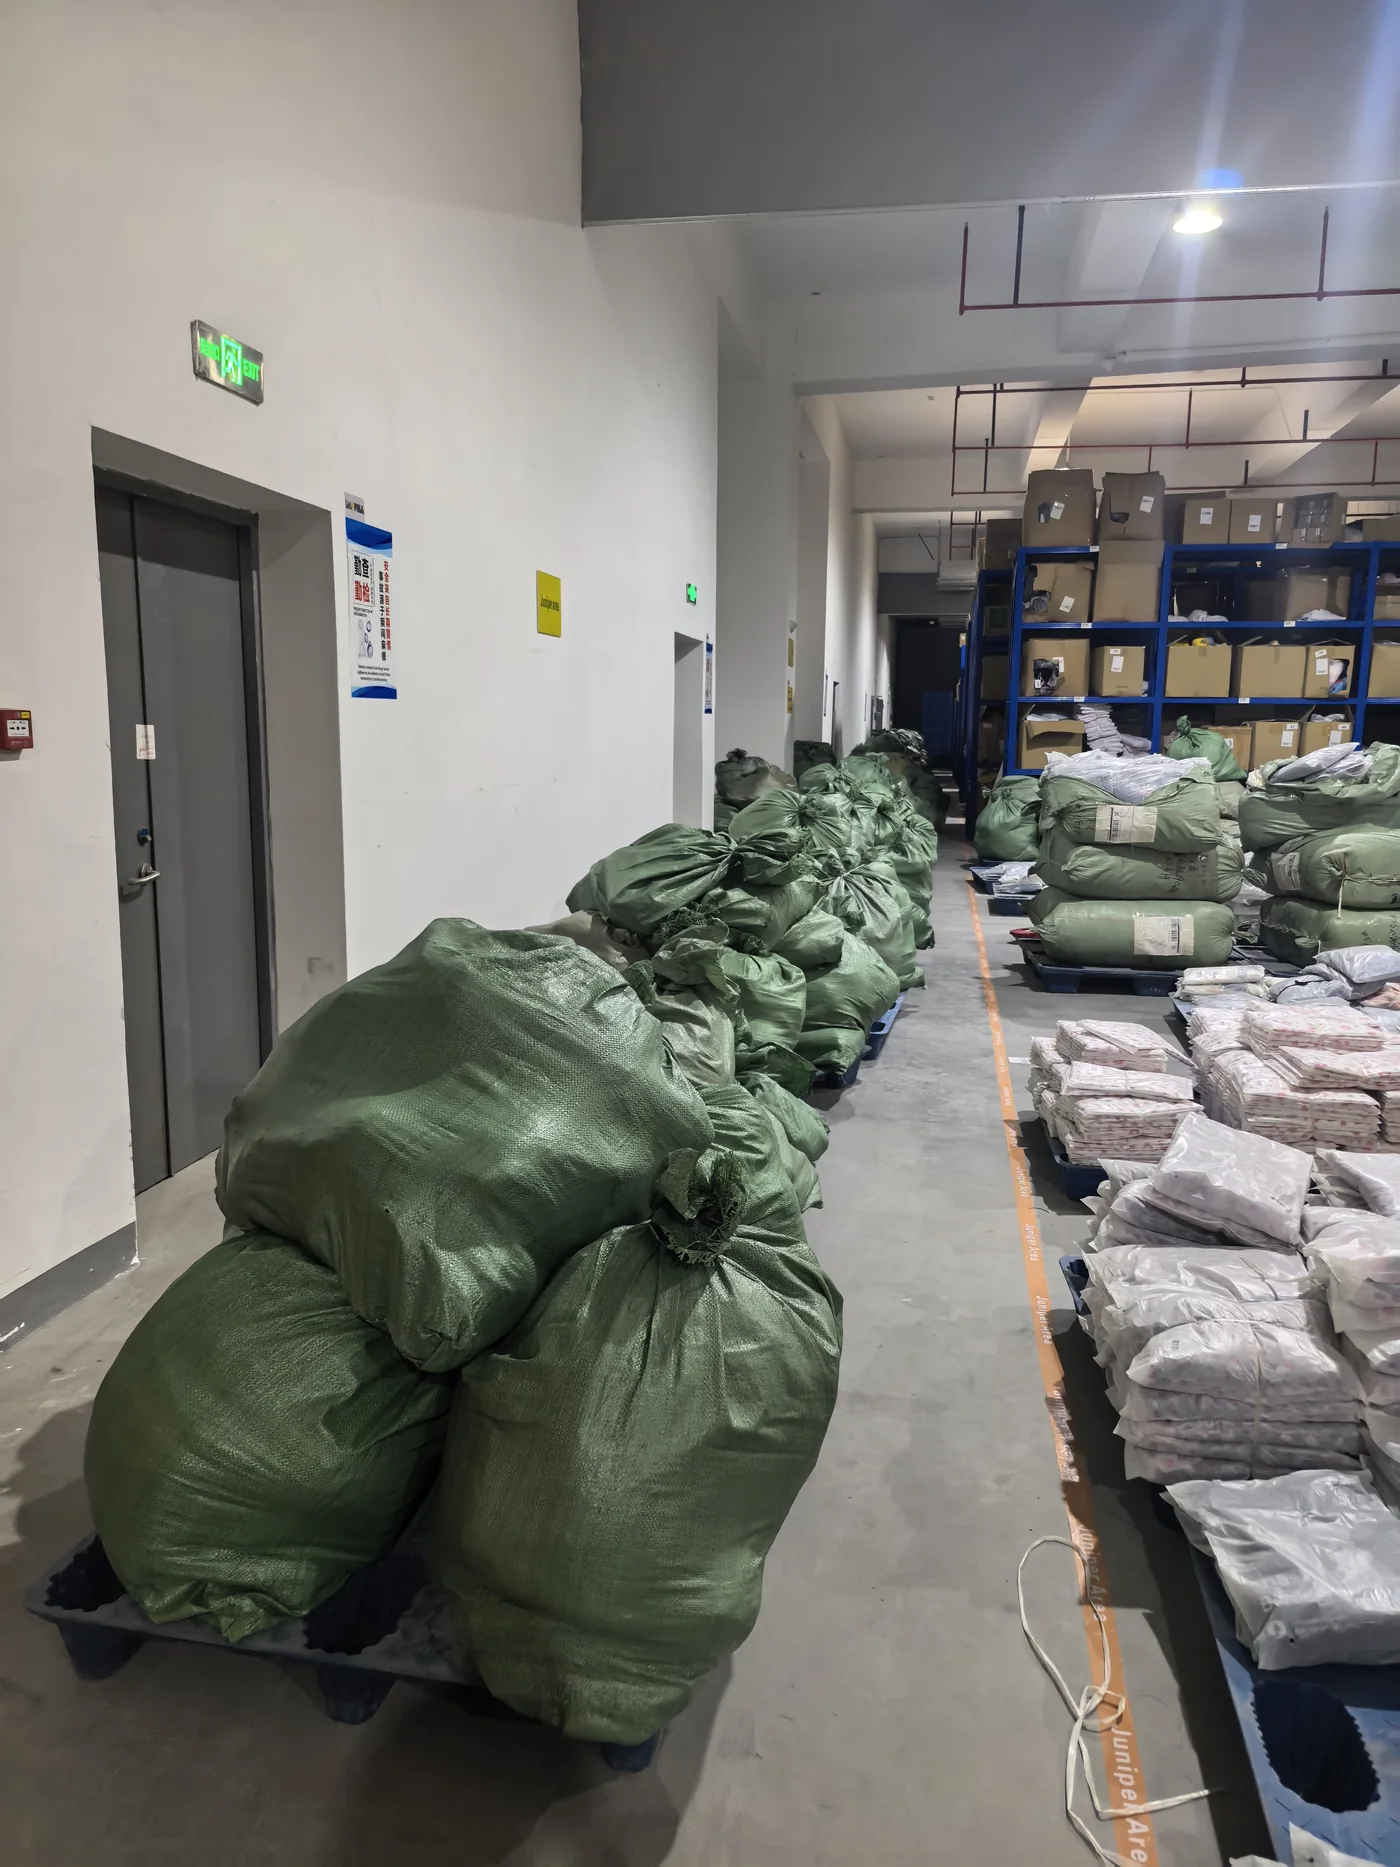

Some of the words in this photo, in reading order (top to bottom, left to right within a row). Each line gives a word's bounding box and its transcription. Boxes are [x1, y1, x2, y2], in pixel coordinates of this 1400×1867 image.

[243, 357, 260, 382] EXIT
[1036, 1295, 1049, 1325] Juniper
[1125, 1817, 1150, 1866] Are
